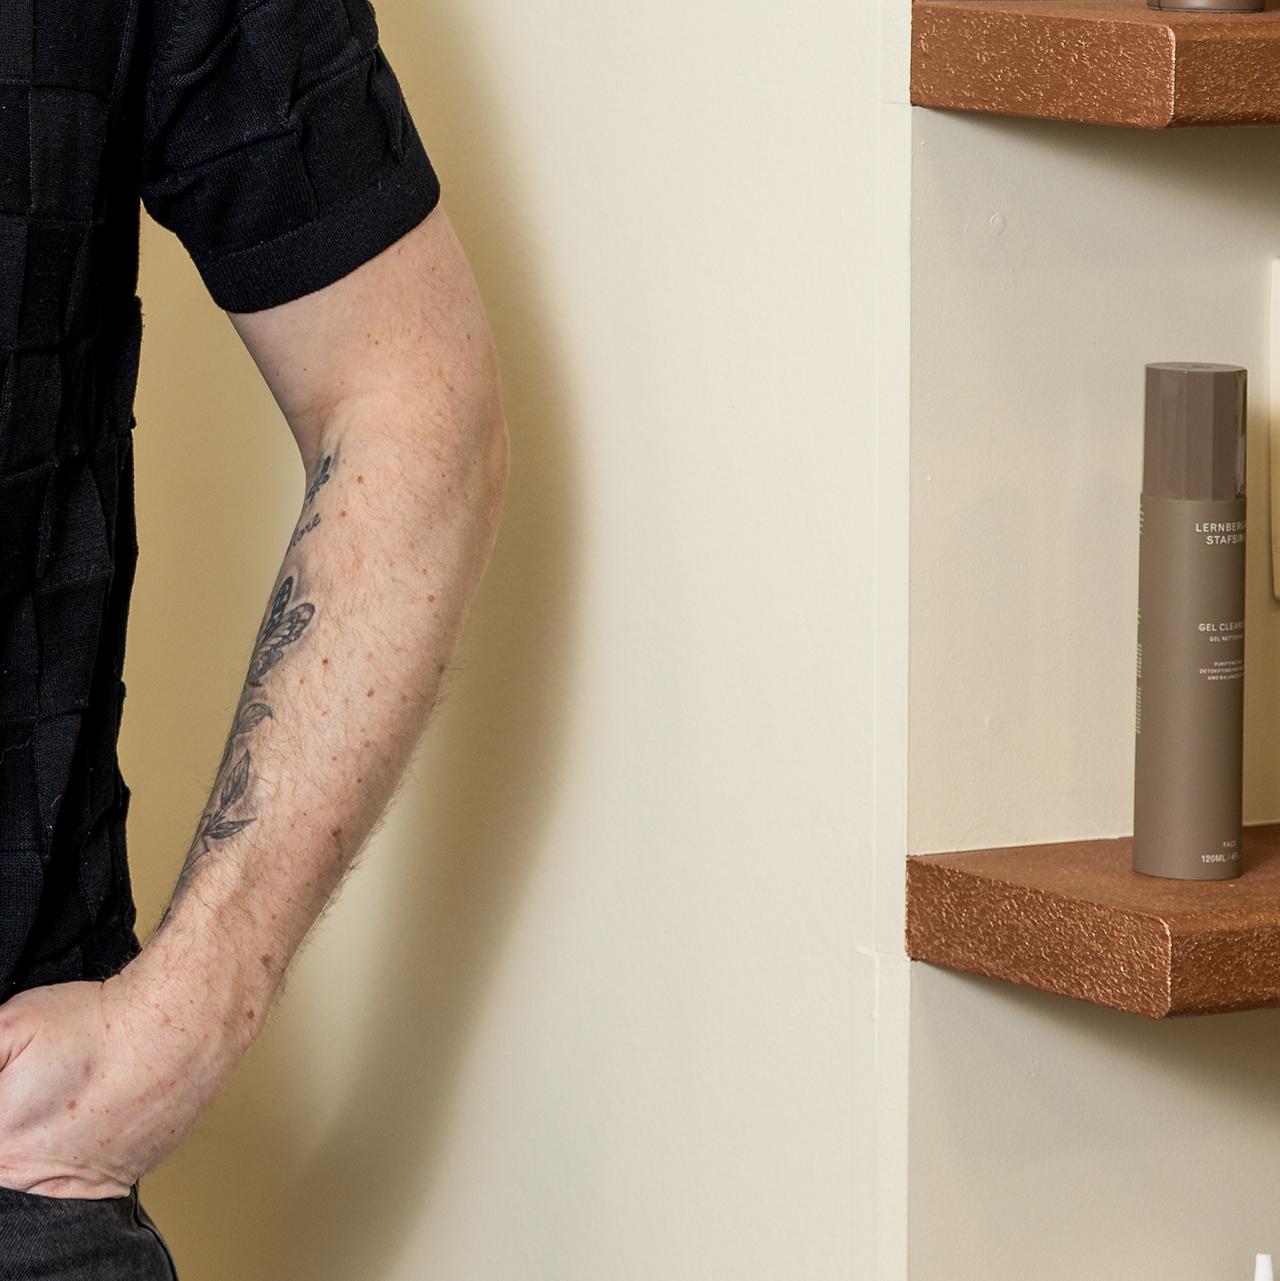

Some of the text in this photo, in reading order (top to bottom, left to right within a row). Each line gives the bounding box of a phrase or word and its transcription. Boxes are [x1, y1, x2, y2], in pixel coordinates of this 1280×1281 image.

[1195, 521, 1246, 533] LERNBER
[1206, 533, 1246, 546] STAFSIN
[1198, 623, 1217, 632] GEL
[1201, 853, 1227, 863] 120ML
